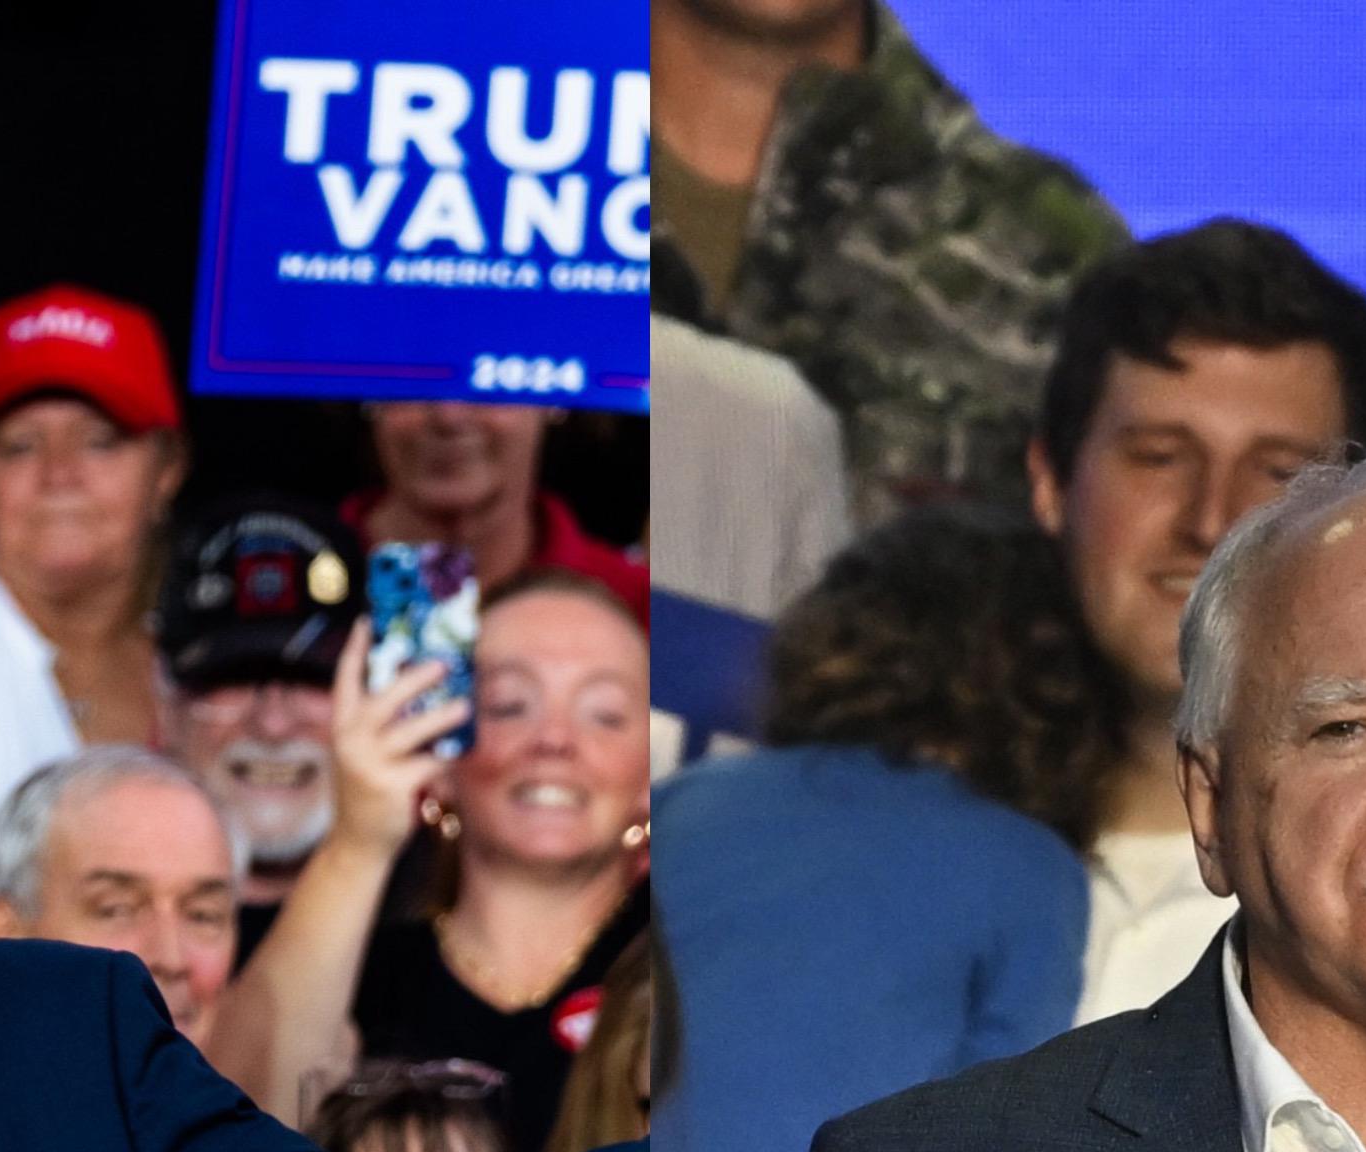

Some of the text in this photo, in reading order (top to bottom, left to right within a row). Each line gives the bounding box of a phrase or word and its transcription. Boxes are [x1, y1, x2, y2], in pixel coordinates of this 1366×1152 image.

[278, 254, 650, 293] MAKE AMERICA GREA
[473, 354, 584, 393] 2024
